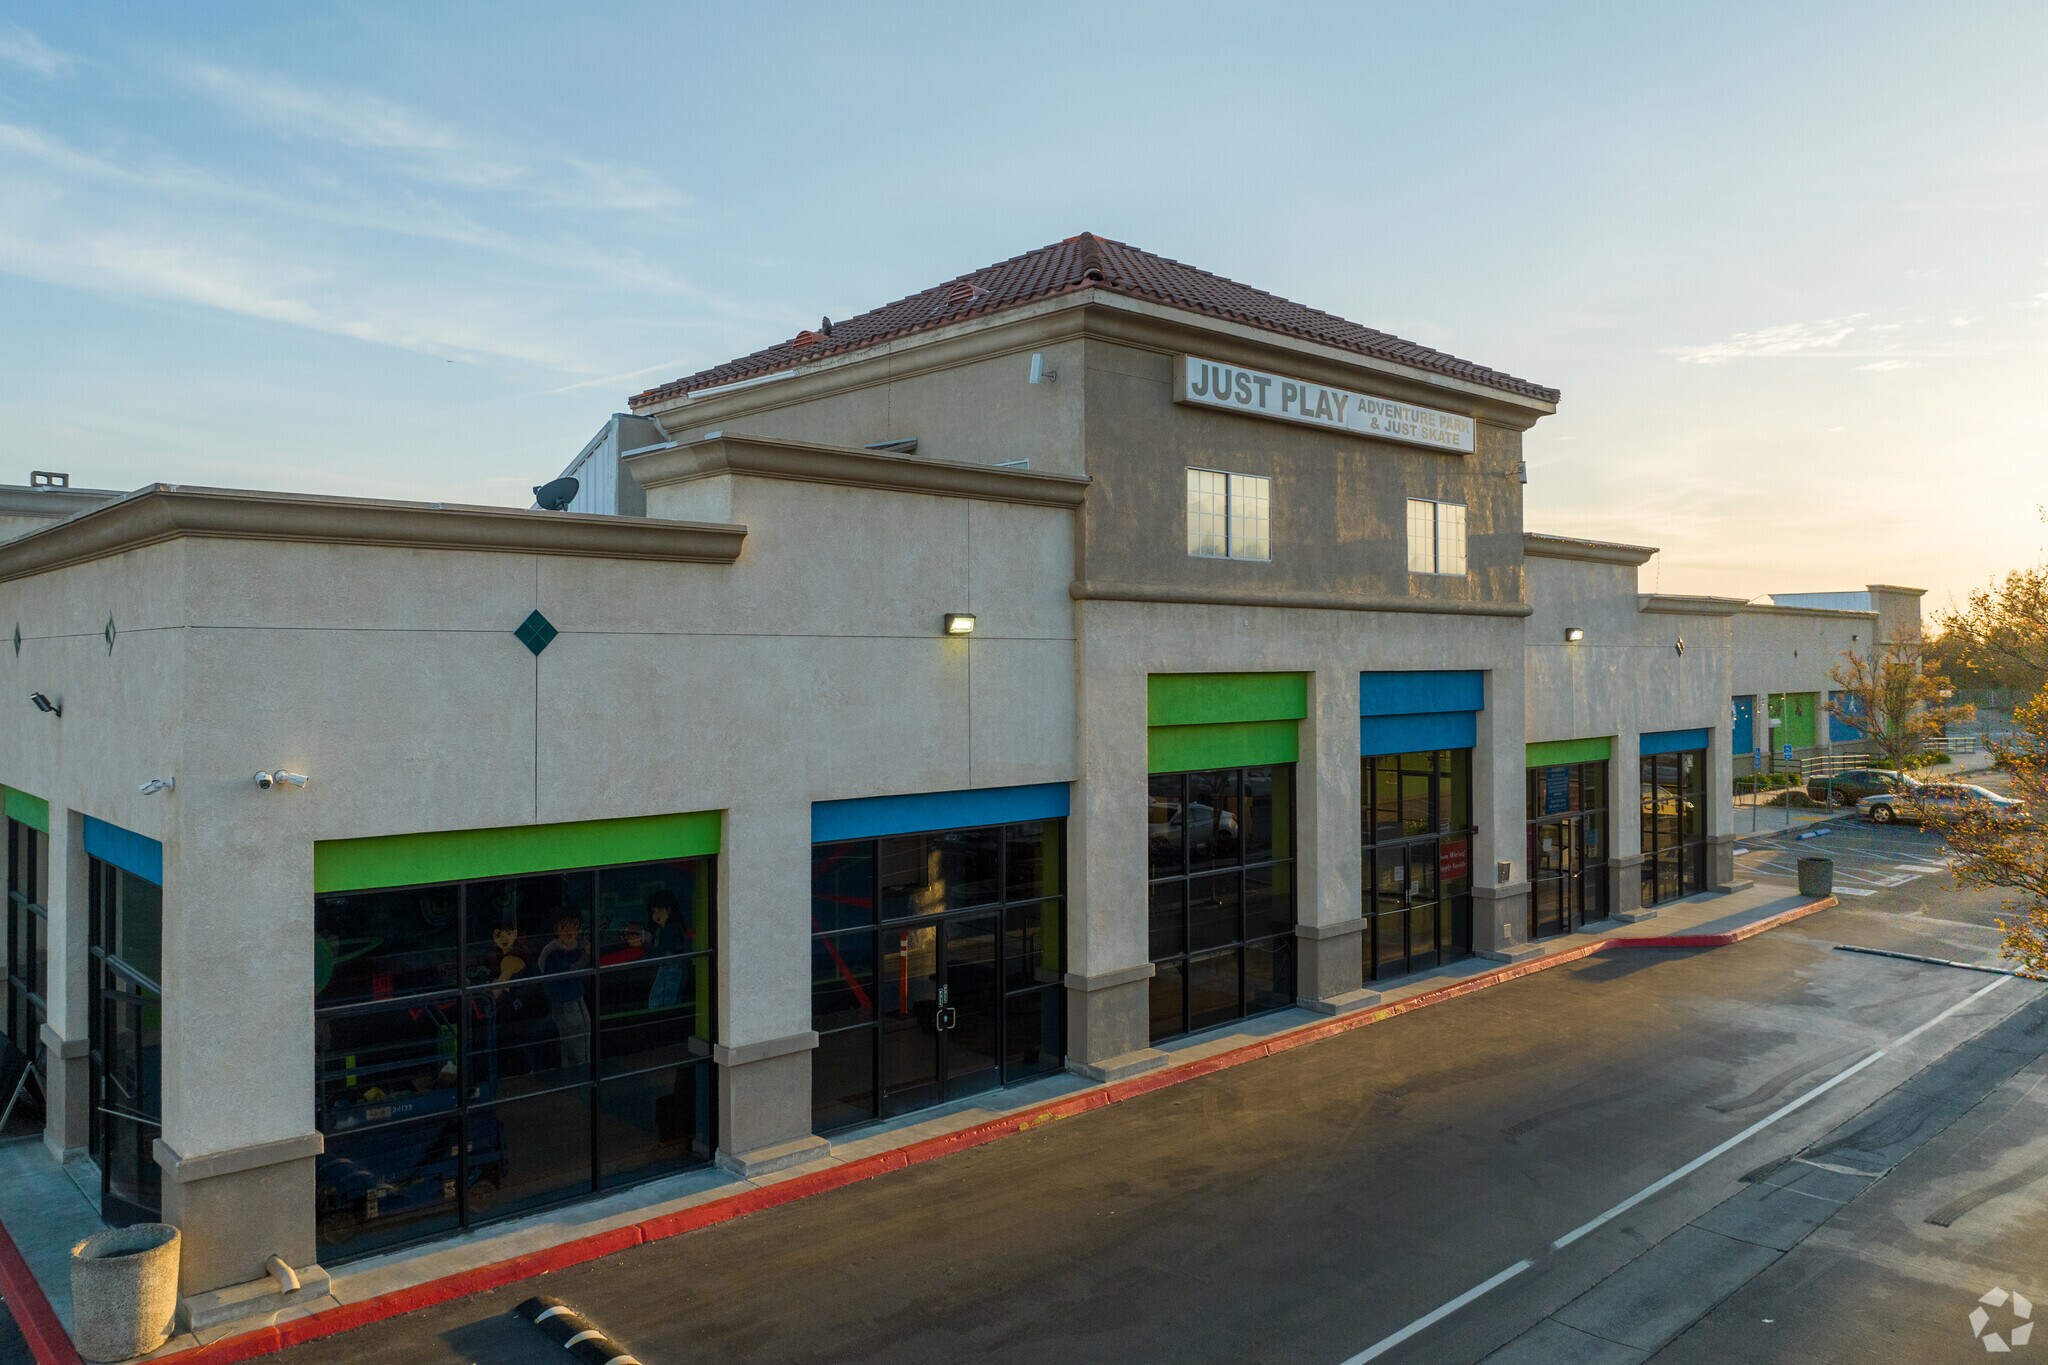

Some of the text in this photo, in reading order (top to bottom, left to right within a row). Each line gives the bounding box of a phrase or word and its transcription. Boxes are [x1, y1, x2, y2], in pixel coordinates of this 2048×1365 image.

[1191, 364, 1348, 423] JUST PLAY
[1357, 398, 1471, 434] ADVENTURE PARK
[1370, 417, 1460, 446] & JUST SKATE
